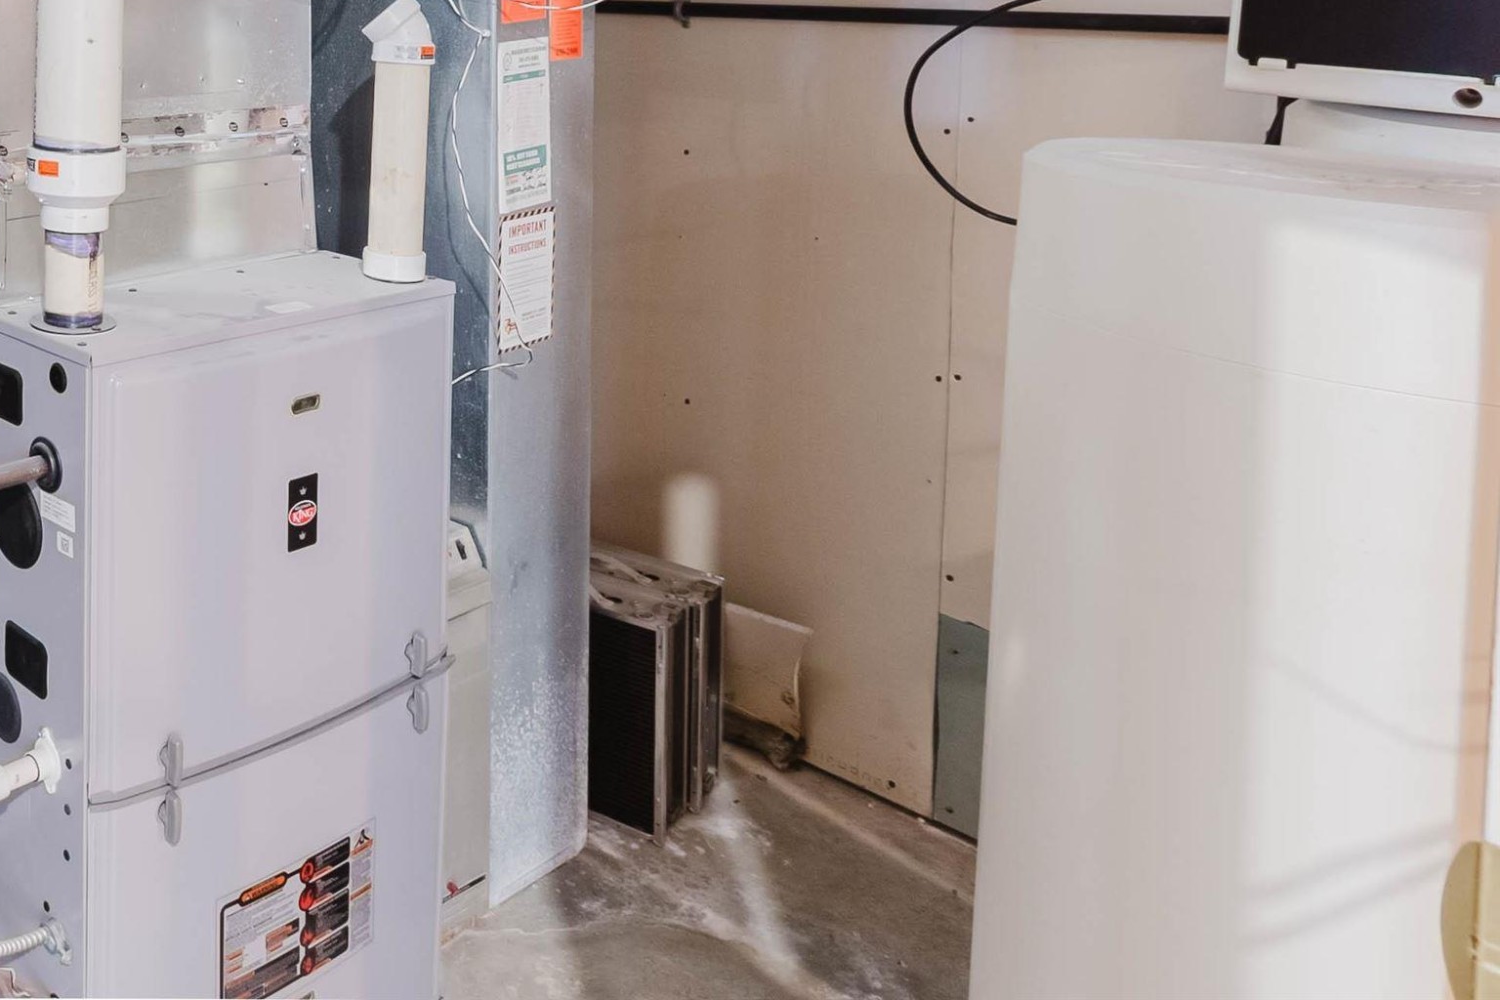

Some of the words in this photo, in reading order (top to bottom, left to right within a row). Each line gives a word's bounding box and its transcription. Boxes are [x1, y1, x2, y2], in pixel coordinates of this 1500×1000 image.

[508, 219, 547, 238] IMPORTANT
[508, 238, 547, 255] INSTRUCTIONS
[292, 507, 315, 523] KING
